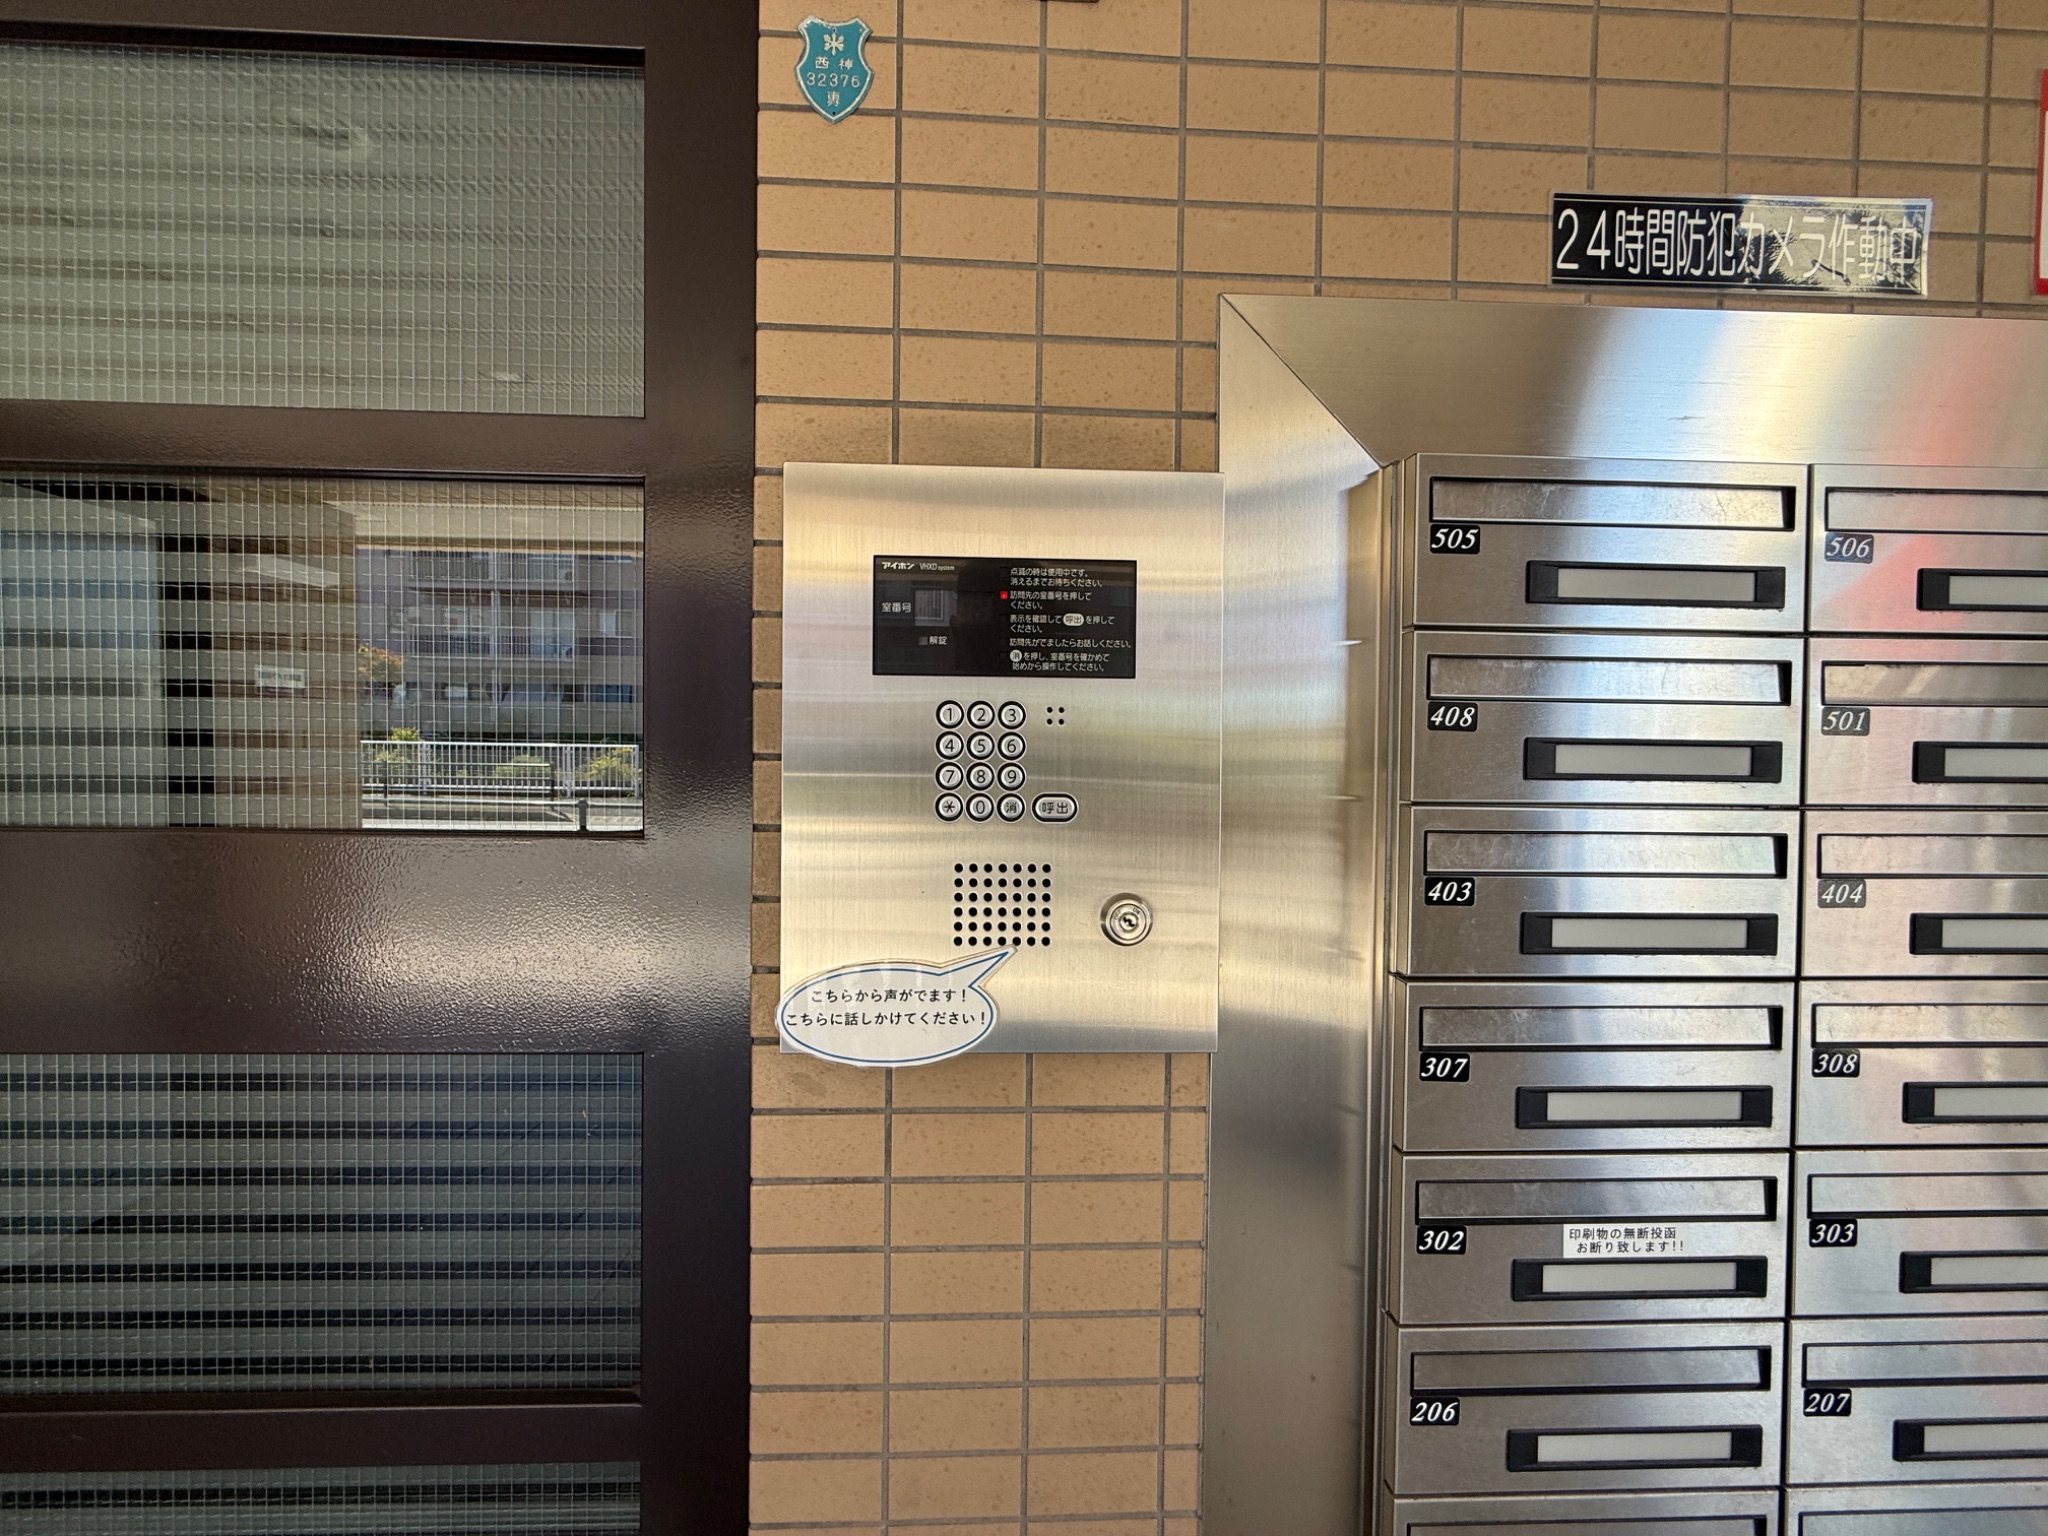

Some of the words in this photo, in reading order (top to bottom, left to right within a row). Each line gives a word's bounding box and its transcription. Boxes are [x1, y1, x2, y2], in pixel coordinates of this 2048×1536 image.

[807, 72, 860, 88] 32376
[1556, 207, 1918, 281] 24時間防犯カメラ作動中
[1431, 528, 1479, 549] 505
[1825, 537, 1872, 558] 506
[881, 562, 915, 570] アイホン
[1010, 577, 1102, 587] 消えるまでお待ちください。
[1010, 591, 1092, 600] 訪問先の室番号を押して
[881, 602, 911, 613] 室番号
[1010, 600, 1043, 610] ください。
[1010, 624, 1043, 633] ください。
[928, 635, 947, 645] 解錠
[1012, 662, 1105, 672] 始めから操作してください。
[946, 708, 953, 721] 1
[977, 708, 986, 722] 2
[1008, 708, 1017, 722] 3
[1430, 706, 1475, 727] 408
[1823, 711, 1866, 731] 501
[945, 739, 955, 752] 4
[977, 739, 986, 753] 5
[1007, 739, 1016, 753] 6
[945, 770, 955, 783] 7
[976, 770, 986, 784] 8
[1007, 770, 1017, 784] 9
[976, 800, 985, 814] 0
[1041, 802, 1068, 814] 呼出
[1428, 881, 1472, 901] 403
[1821, 884, 1864, 904] 404
[811, 989, 966, 1003] こちらから声がでます！
[786, 1012, 986, 1027] こちらに話しかけてください！
[1420, 1057, 1468, 1078] 307
[1814, 1054, 1858, 1074] 308
[1418, 1230, 1464, 1251] 302
[1569, 1227, 1676, 1241] 印刷物の無断投函
[1811, 1223, 1854, 1244] 303
[1805, 1393, 1850, 1413] 207
[1411, 1402, 1459, 1422] 206
